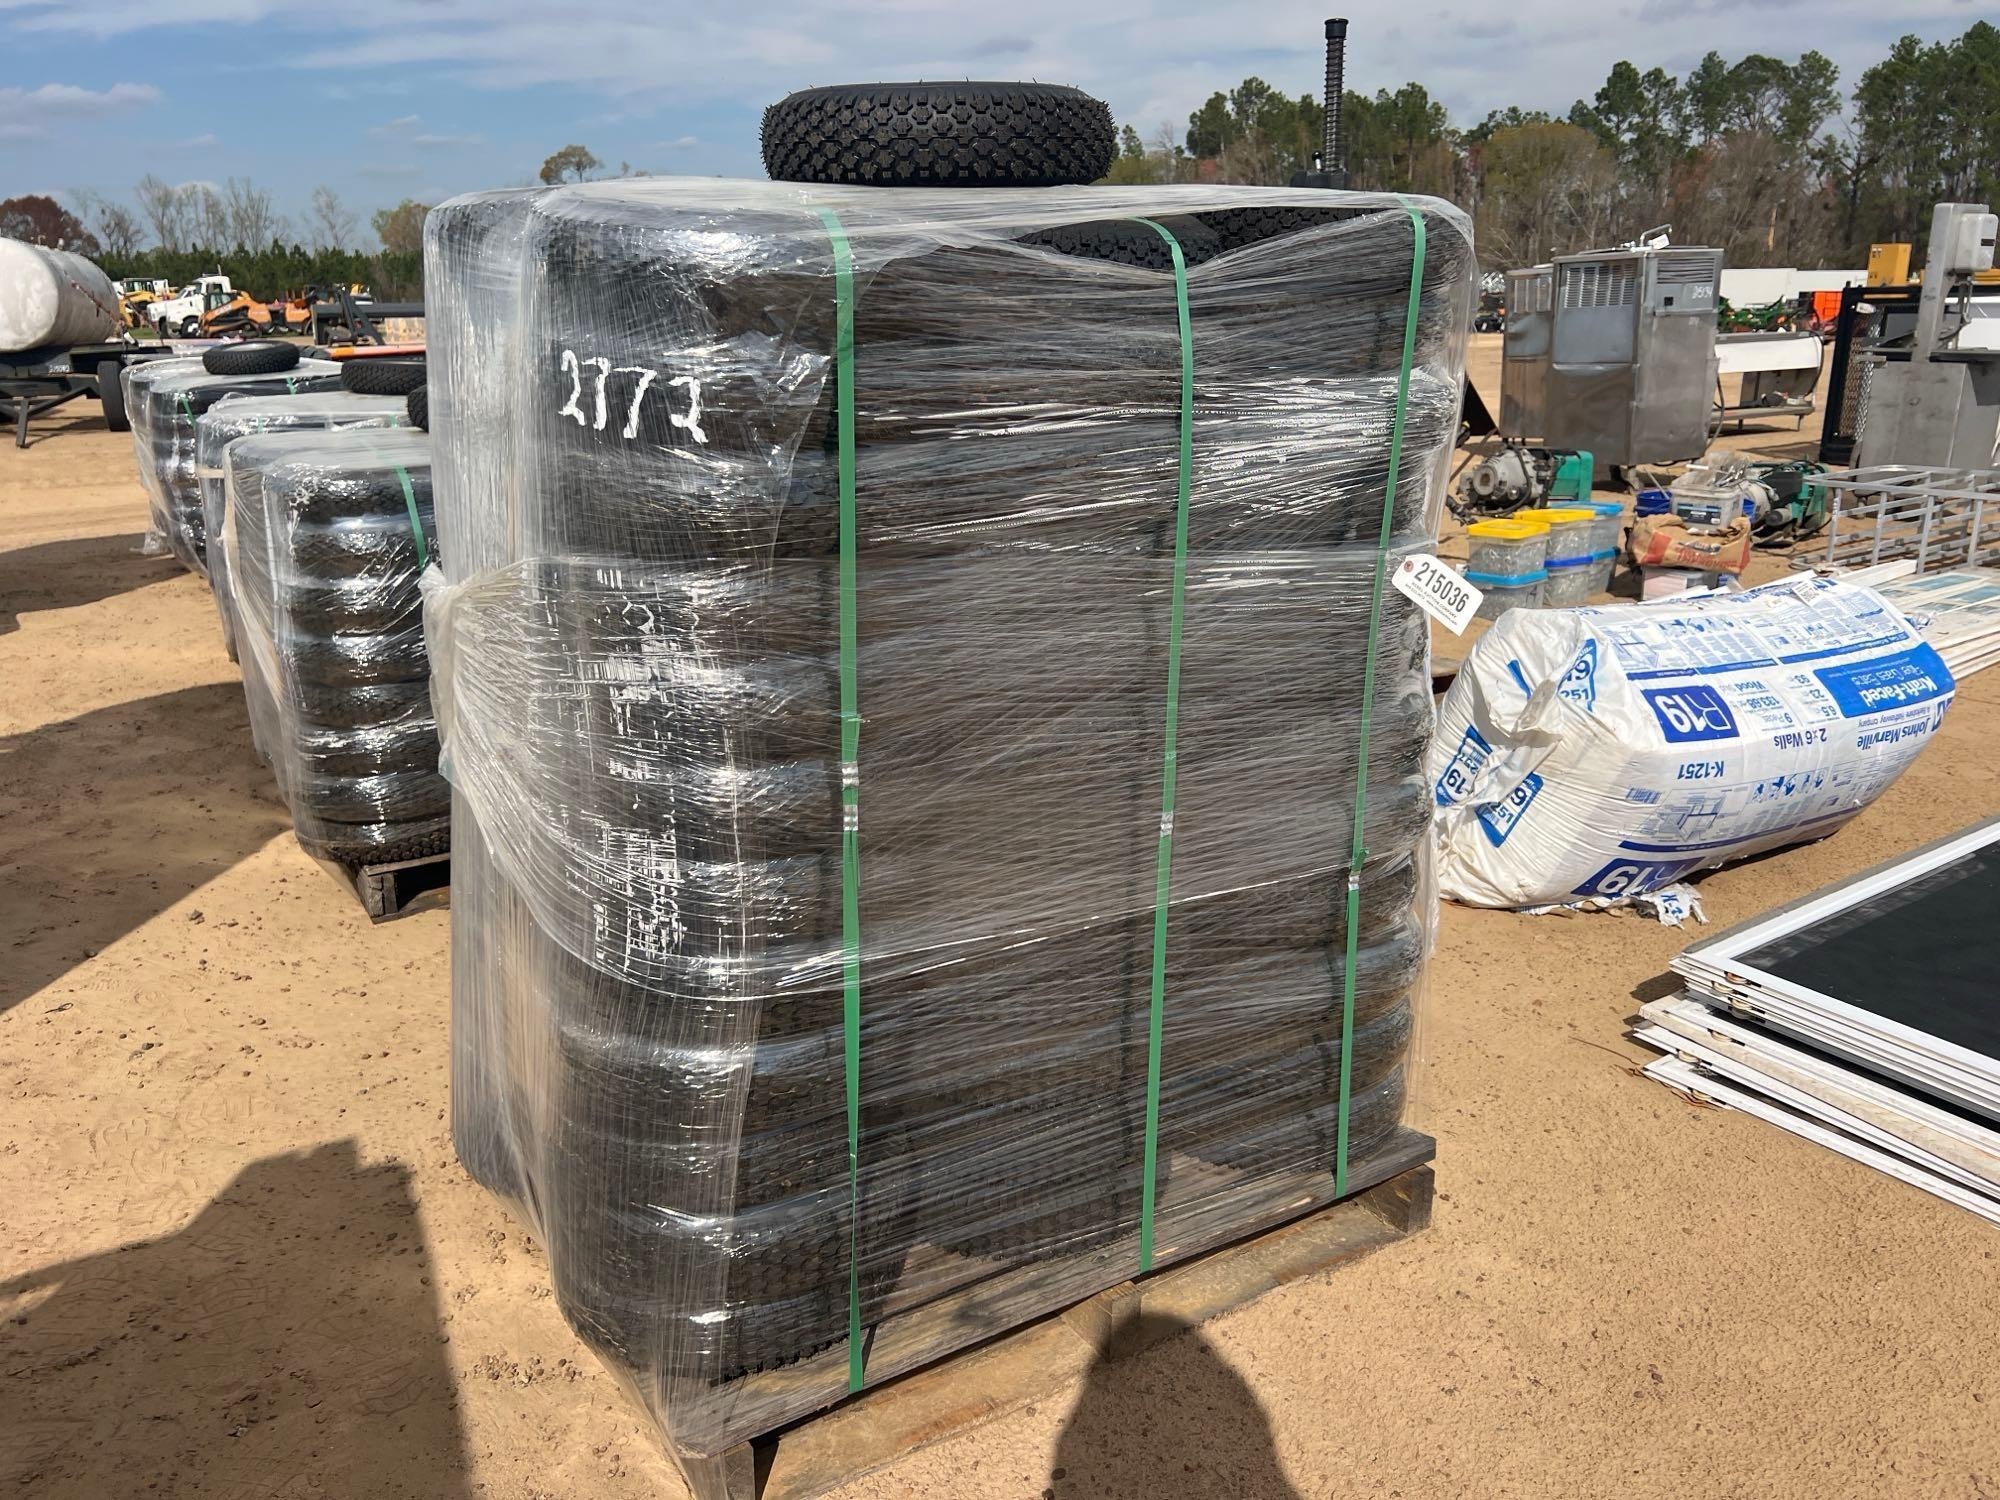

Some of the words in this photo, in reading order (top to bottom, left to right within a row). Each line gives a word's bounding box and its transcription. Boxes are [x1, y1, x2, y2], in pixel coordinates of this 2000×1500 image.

[558, 350, 709, 444] 2772
[1414, 561, 1470, 612] 215036
[1735, 681, 1766, 692] Wood
[1859, 676, 1938, 707] Kraft-Faced
[1654, 692, 1732, 733] R19
[1901, 717, 1931, 738] Johns
[1774, 732, 1804, 750] Walls
[1677, 760, 1725, 780] K-1251
[1596, 865, 1686, 895] R19
